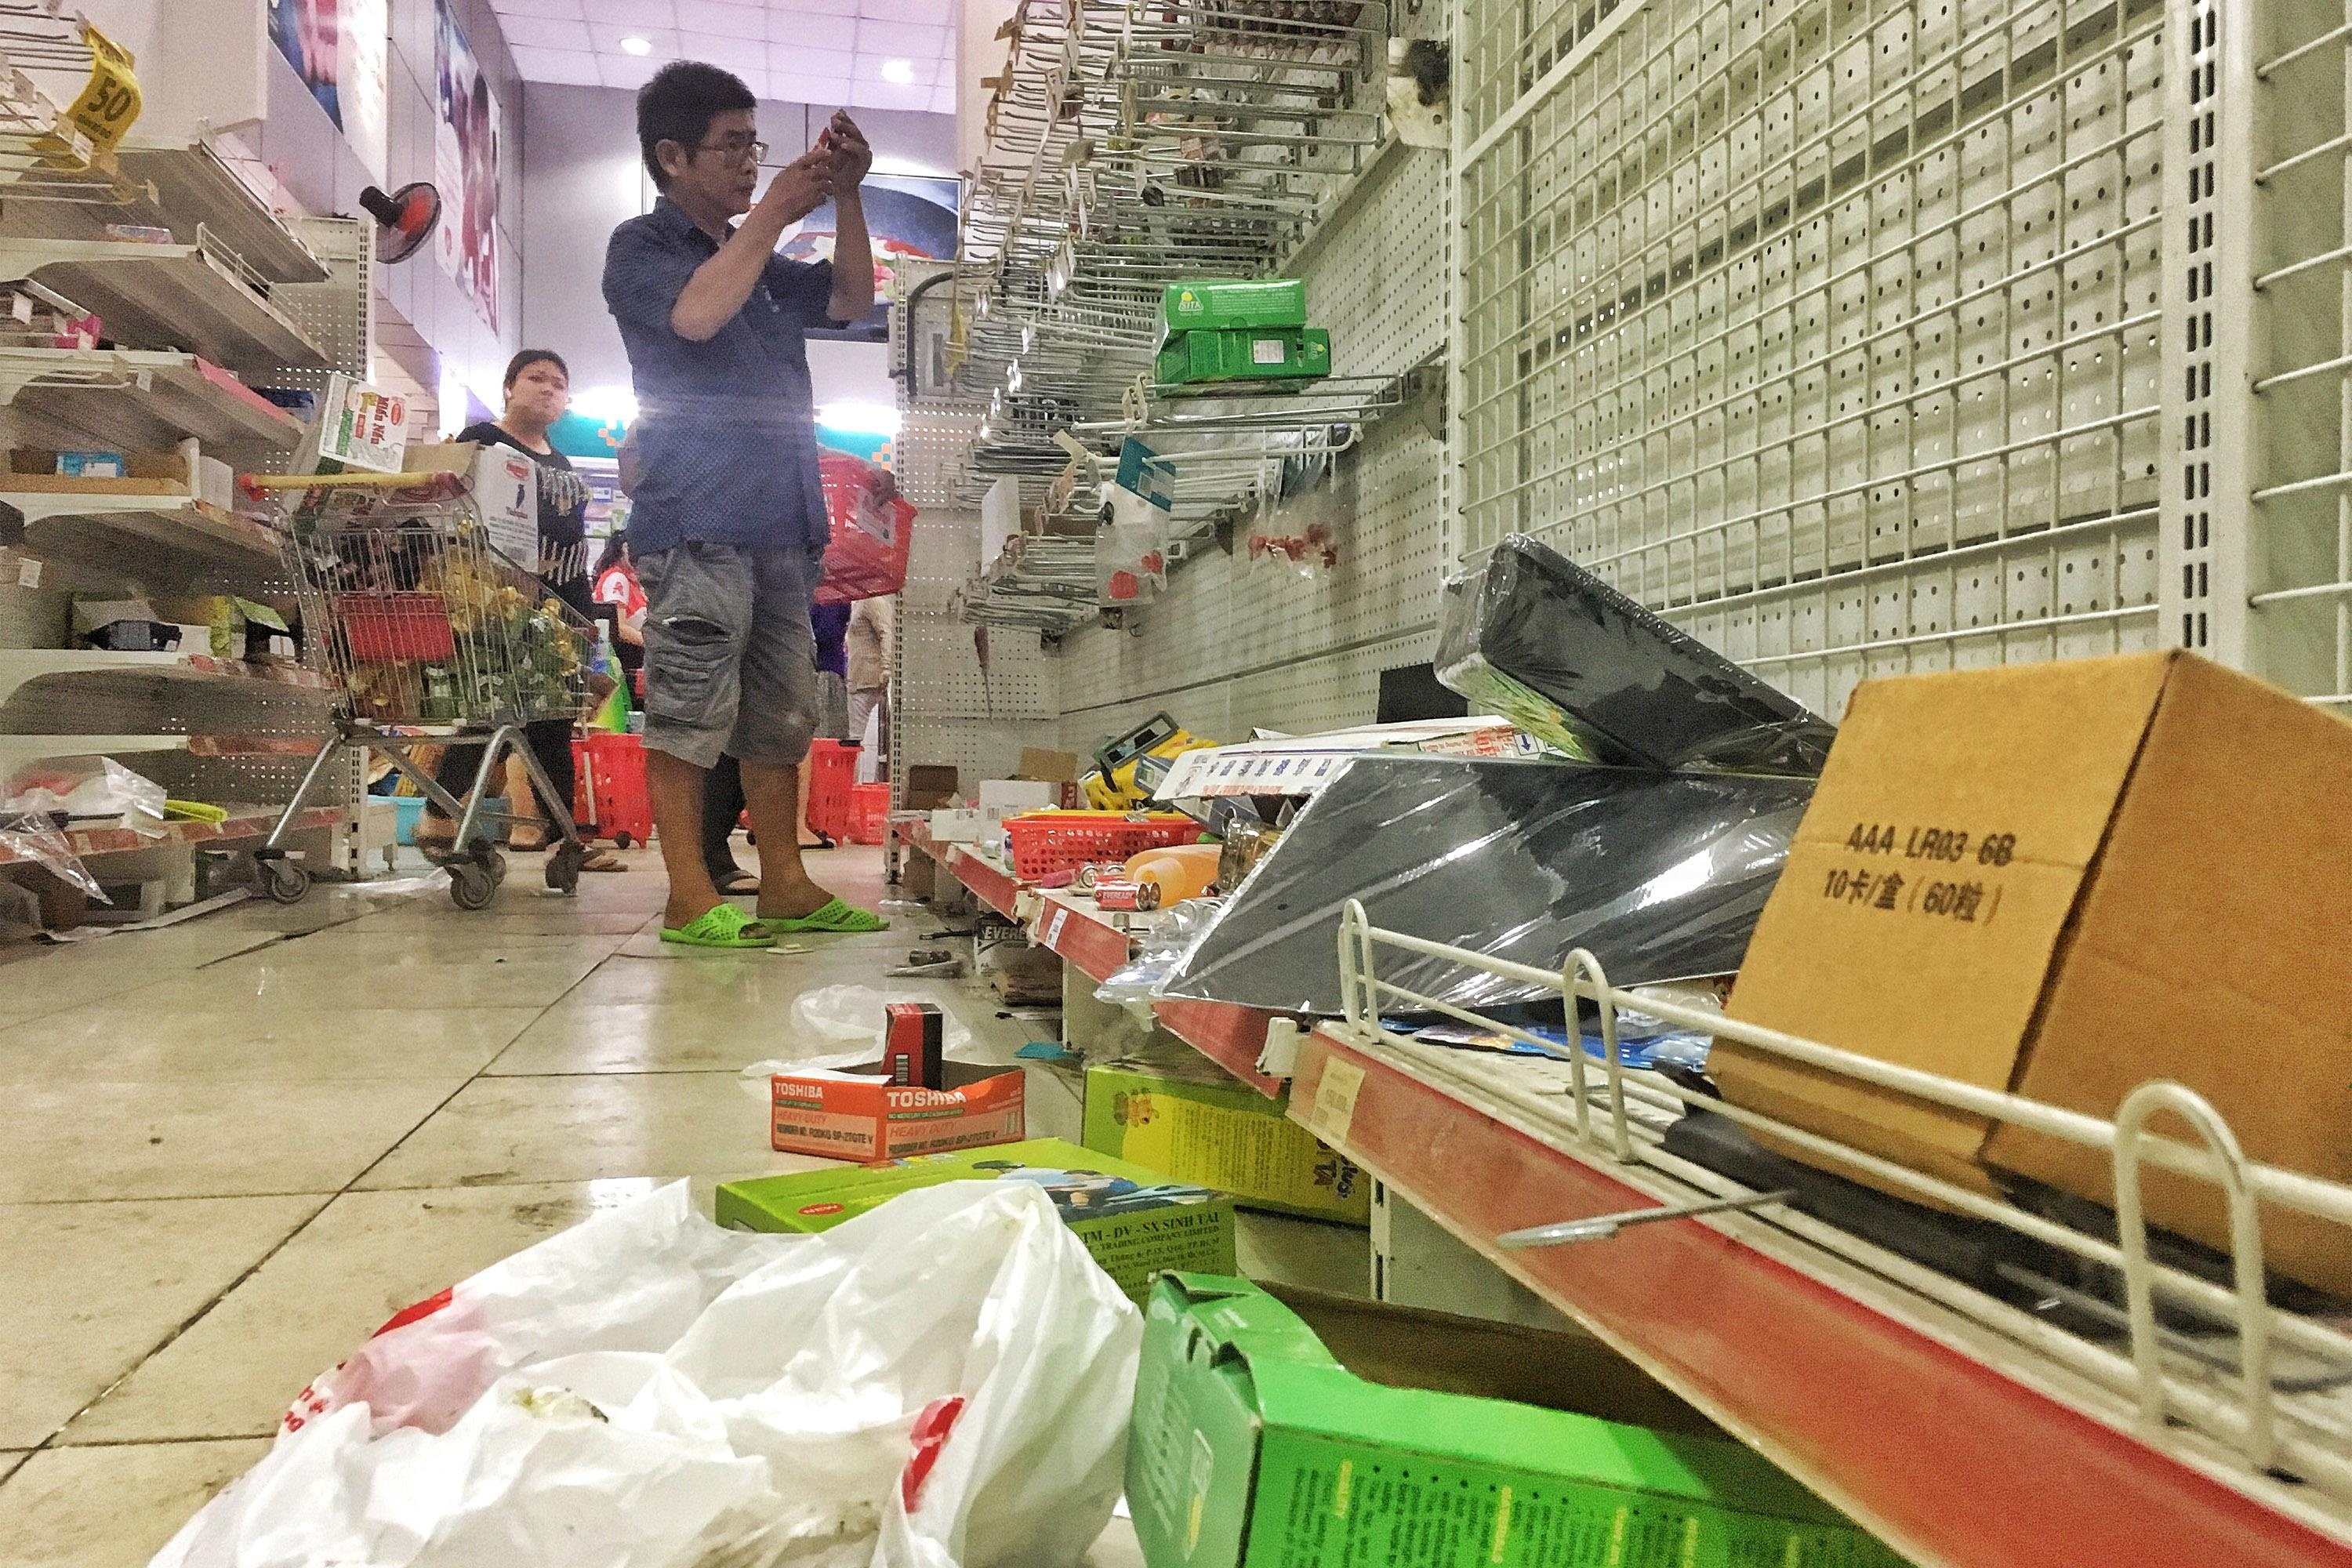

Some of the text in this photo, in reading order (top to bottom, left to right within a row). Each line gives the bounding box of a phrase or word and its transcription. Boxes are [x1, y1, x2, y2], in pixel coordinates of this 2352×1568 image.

[88, 75, 132, 122] 50
[1180, 300, 1203, 310] SITA
[1847, 823, 2016, 867] AAA LR03 6B
[1102, 890, 1134, 900] EVEREADY
[984, 925, 1026, 941] EVERE
[775, 1082, 823, 1099] TOSHIBA
[887, 1091, 967, 1108] TOSHIBA
[776, 1109, 804, 1123] HEAVY
[891, 1124, 928, 1138] HEAVY
[803, 1204, 837, 1214] NEW
[1083, 1230, 1102, 1243] TM
[1114, 1225, 1133, 1239] DV
[1142, 1221, 1160, 1232] SX
[1163, 1215, 1193, 1229] SINH
